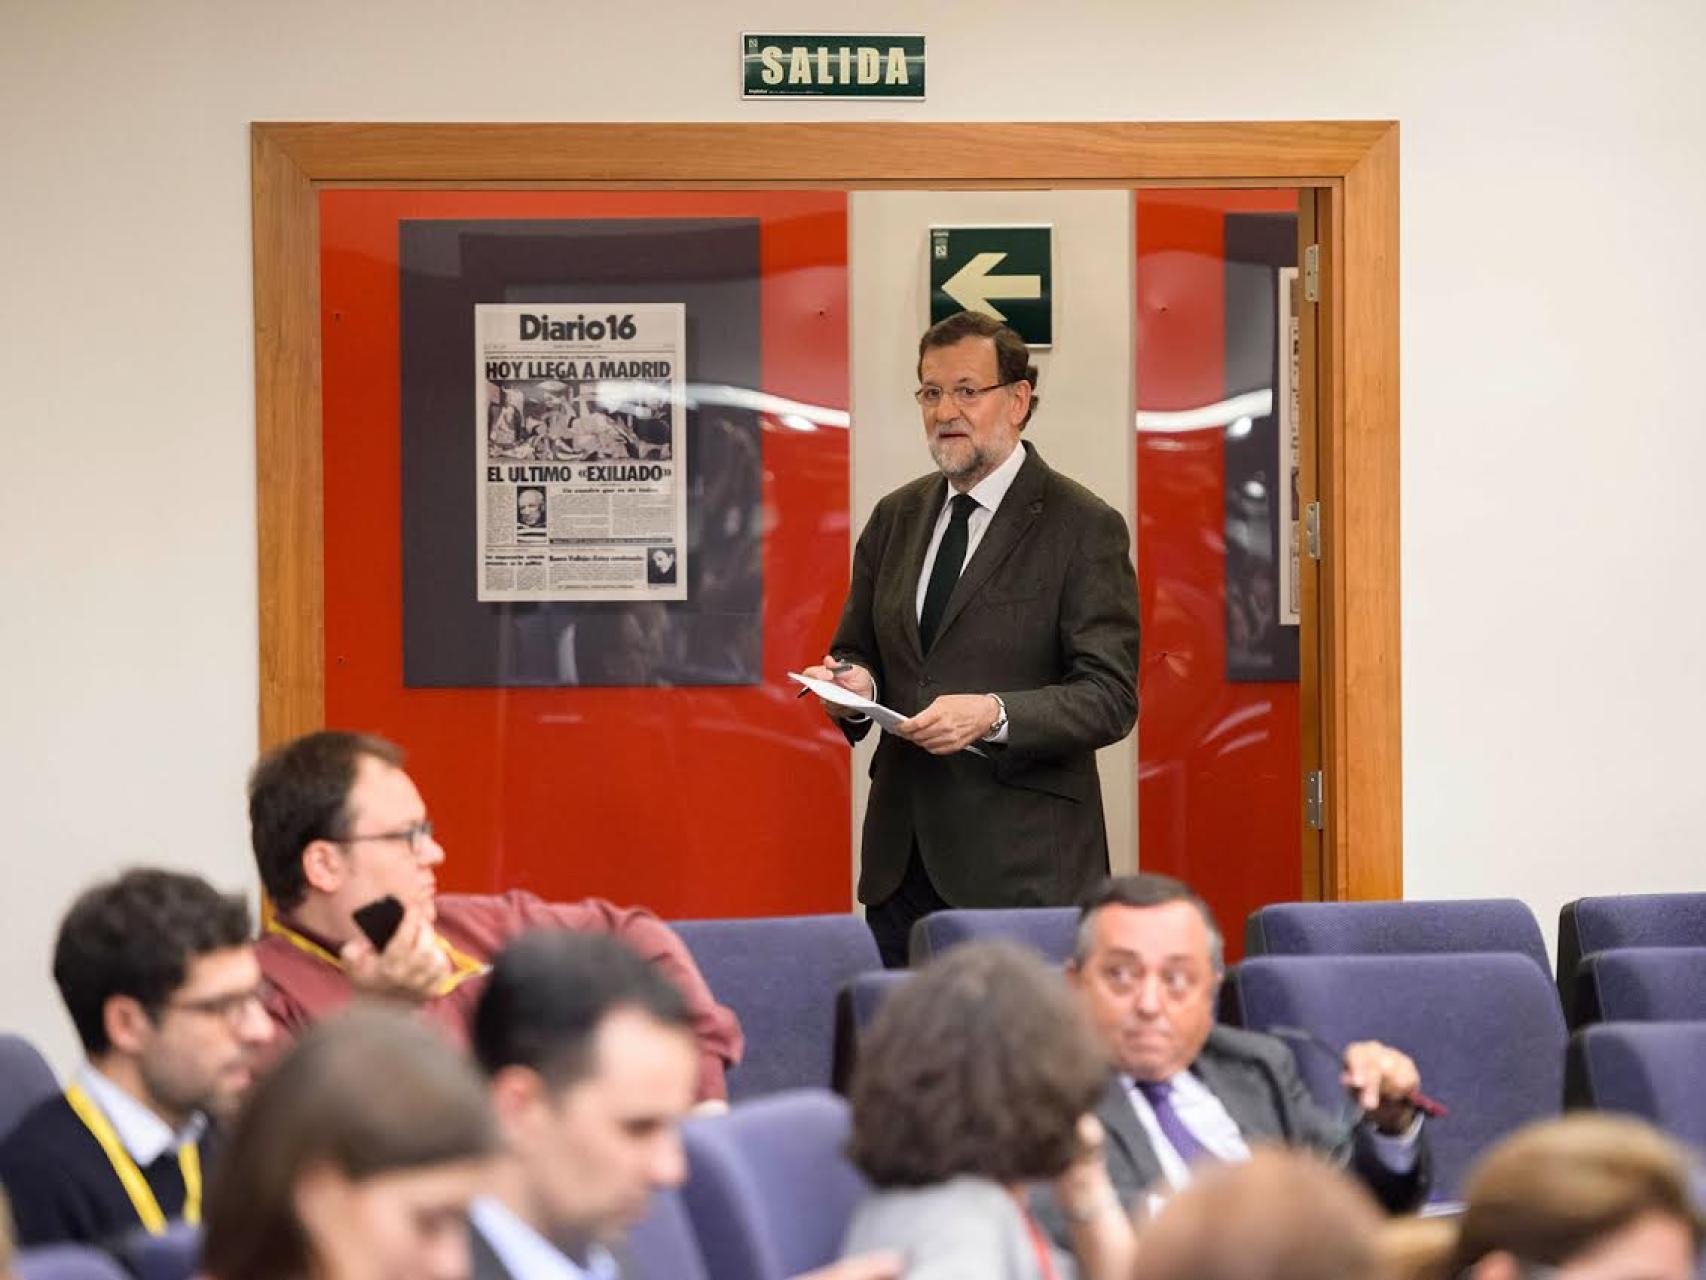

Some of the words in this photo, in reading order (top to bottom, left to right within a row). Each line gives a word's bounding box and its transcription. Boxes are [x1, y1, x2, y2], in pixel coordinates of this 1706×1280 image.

[761, 46, 909, 85] SALIDA
[519, 314, 637, 341] Diario16
[485, 361, 523, 378] HOY
[528, 361, 579, 379] LLEGA
[583, 361, 595, 378] A
[599, 361, 671, 378] MADRID
[487, 466, 504, 482] EL
[508, 465, 572, 482] ULTIMO
